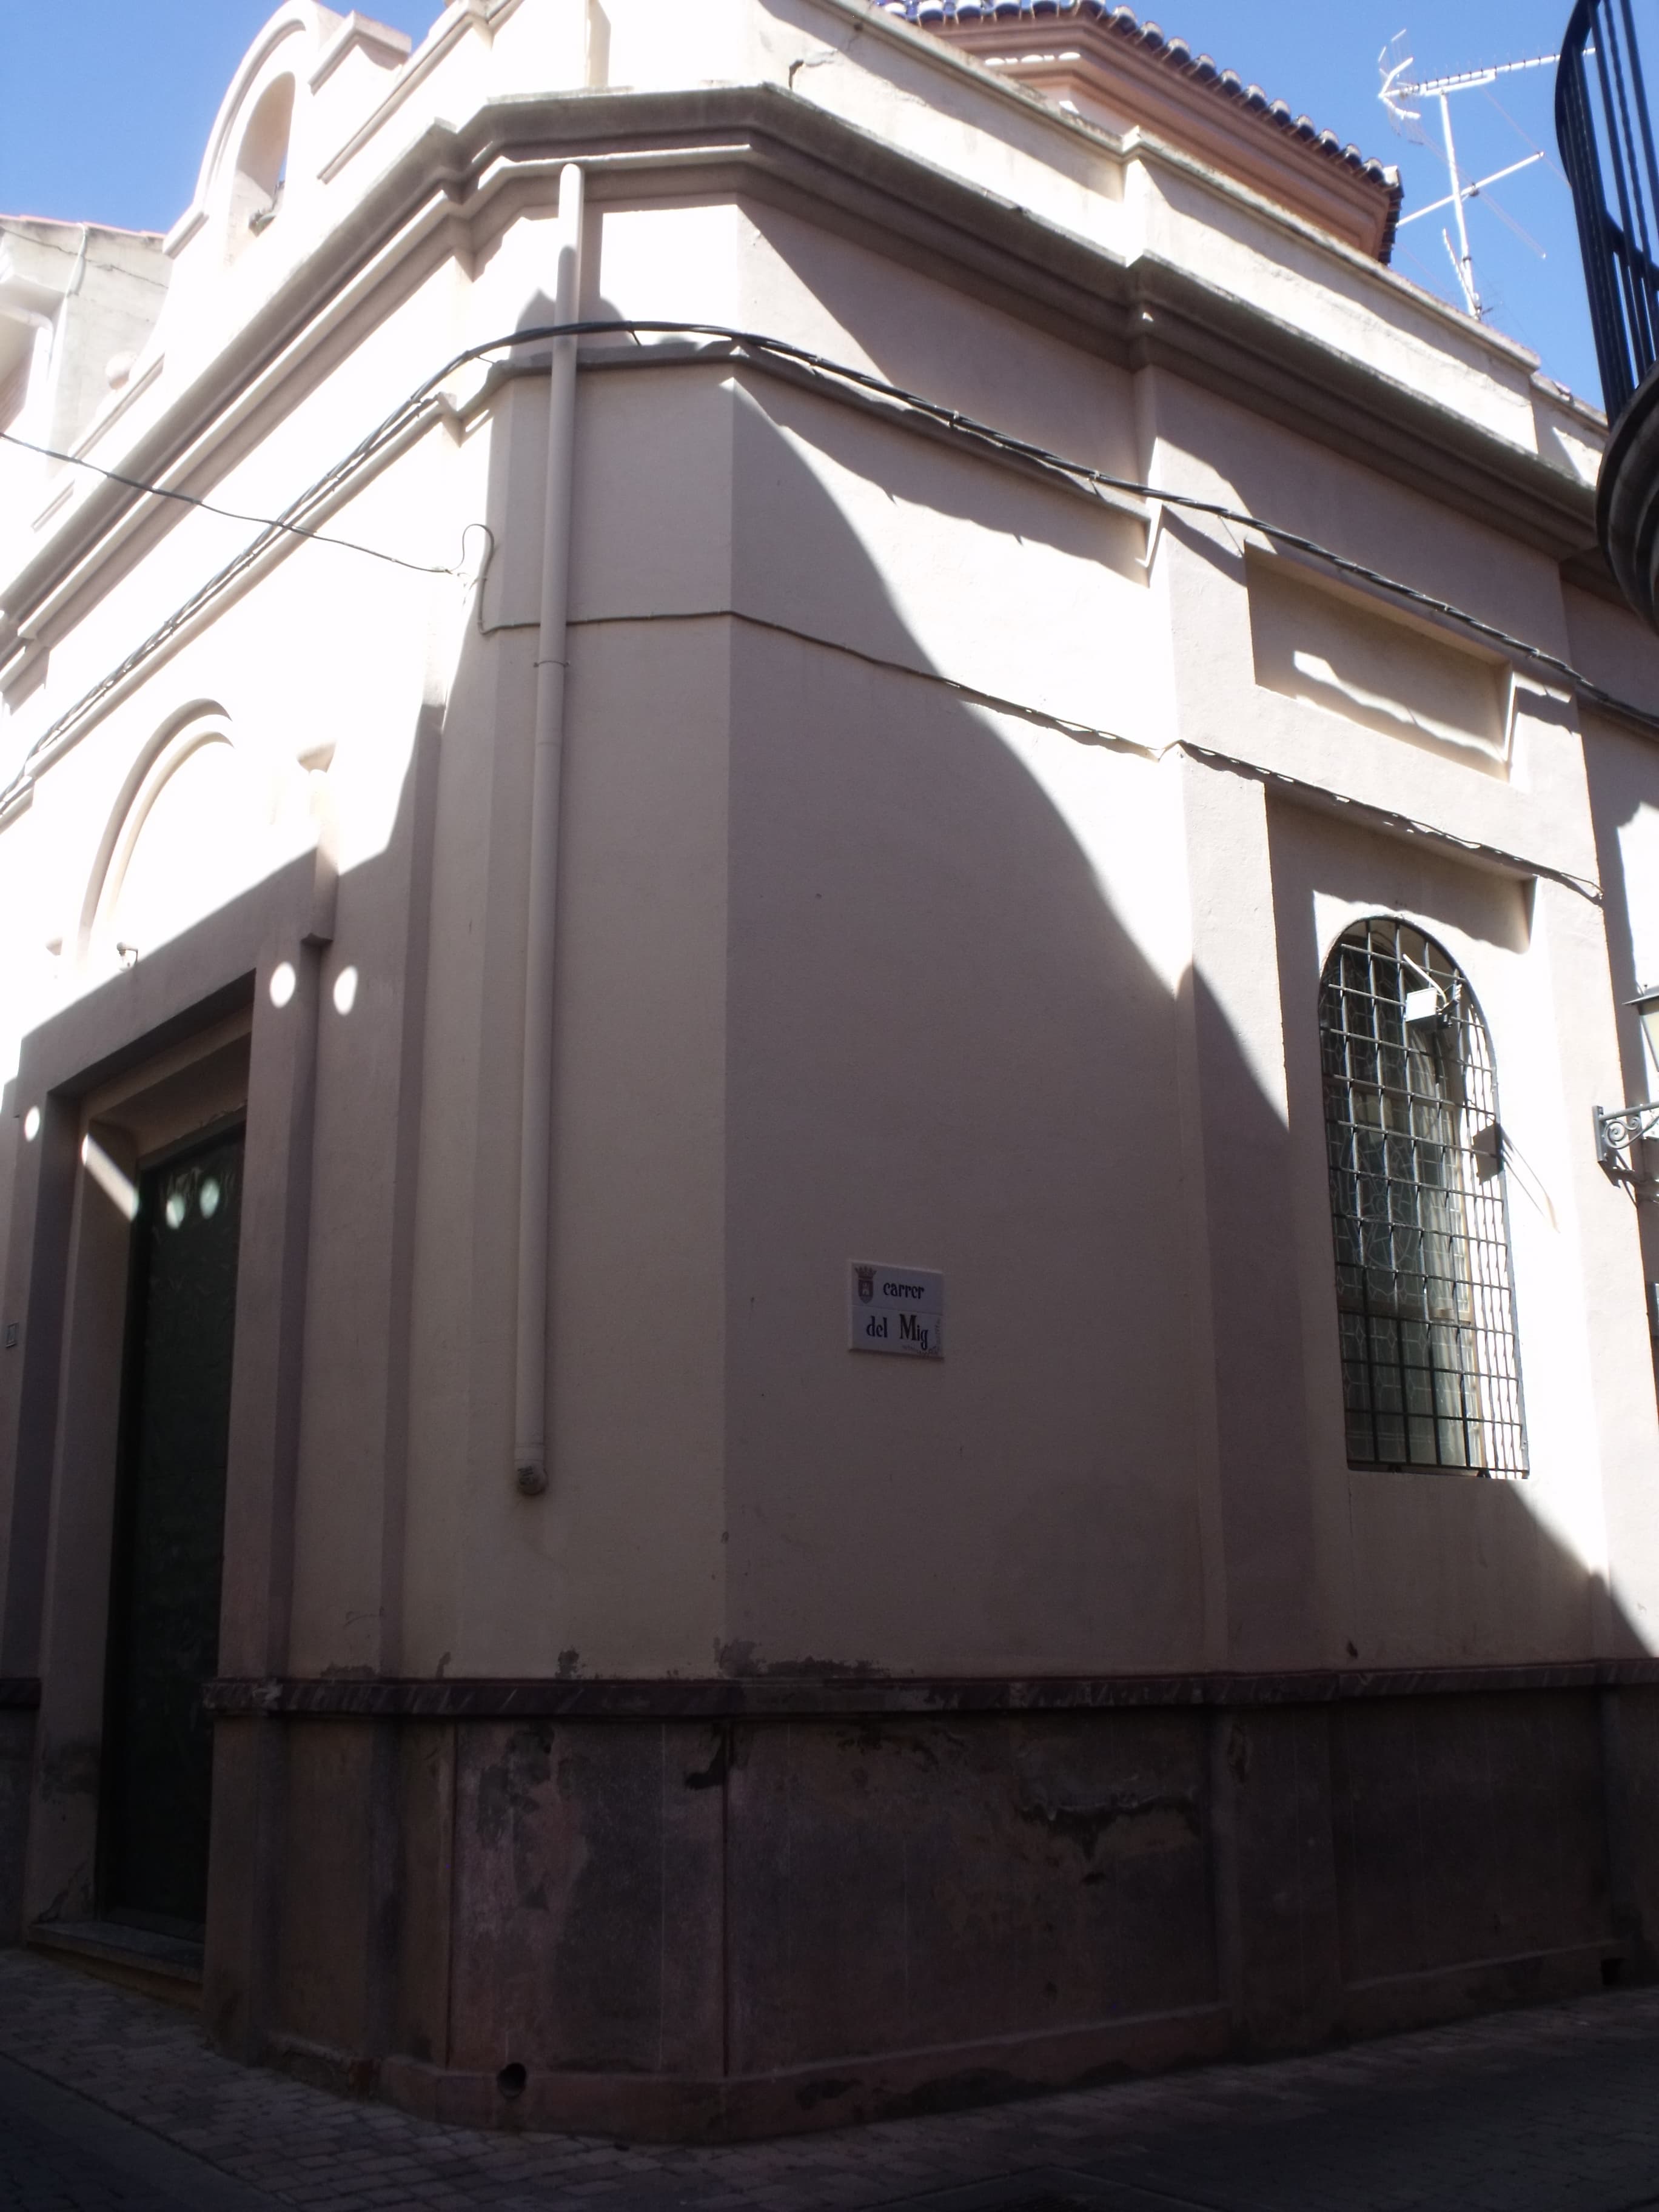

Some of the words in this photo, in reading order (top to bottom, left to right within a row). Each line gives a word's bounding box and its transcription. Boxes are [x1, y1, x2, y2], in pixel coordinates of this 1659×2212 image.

[883, 1282, 925, 1299] carrer
[866, 1315, 888, 1338] del
[899, 1313, 928, 1350] Mig
